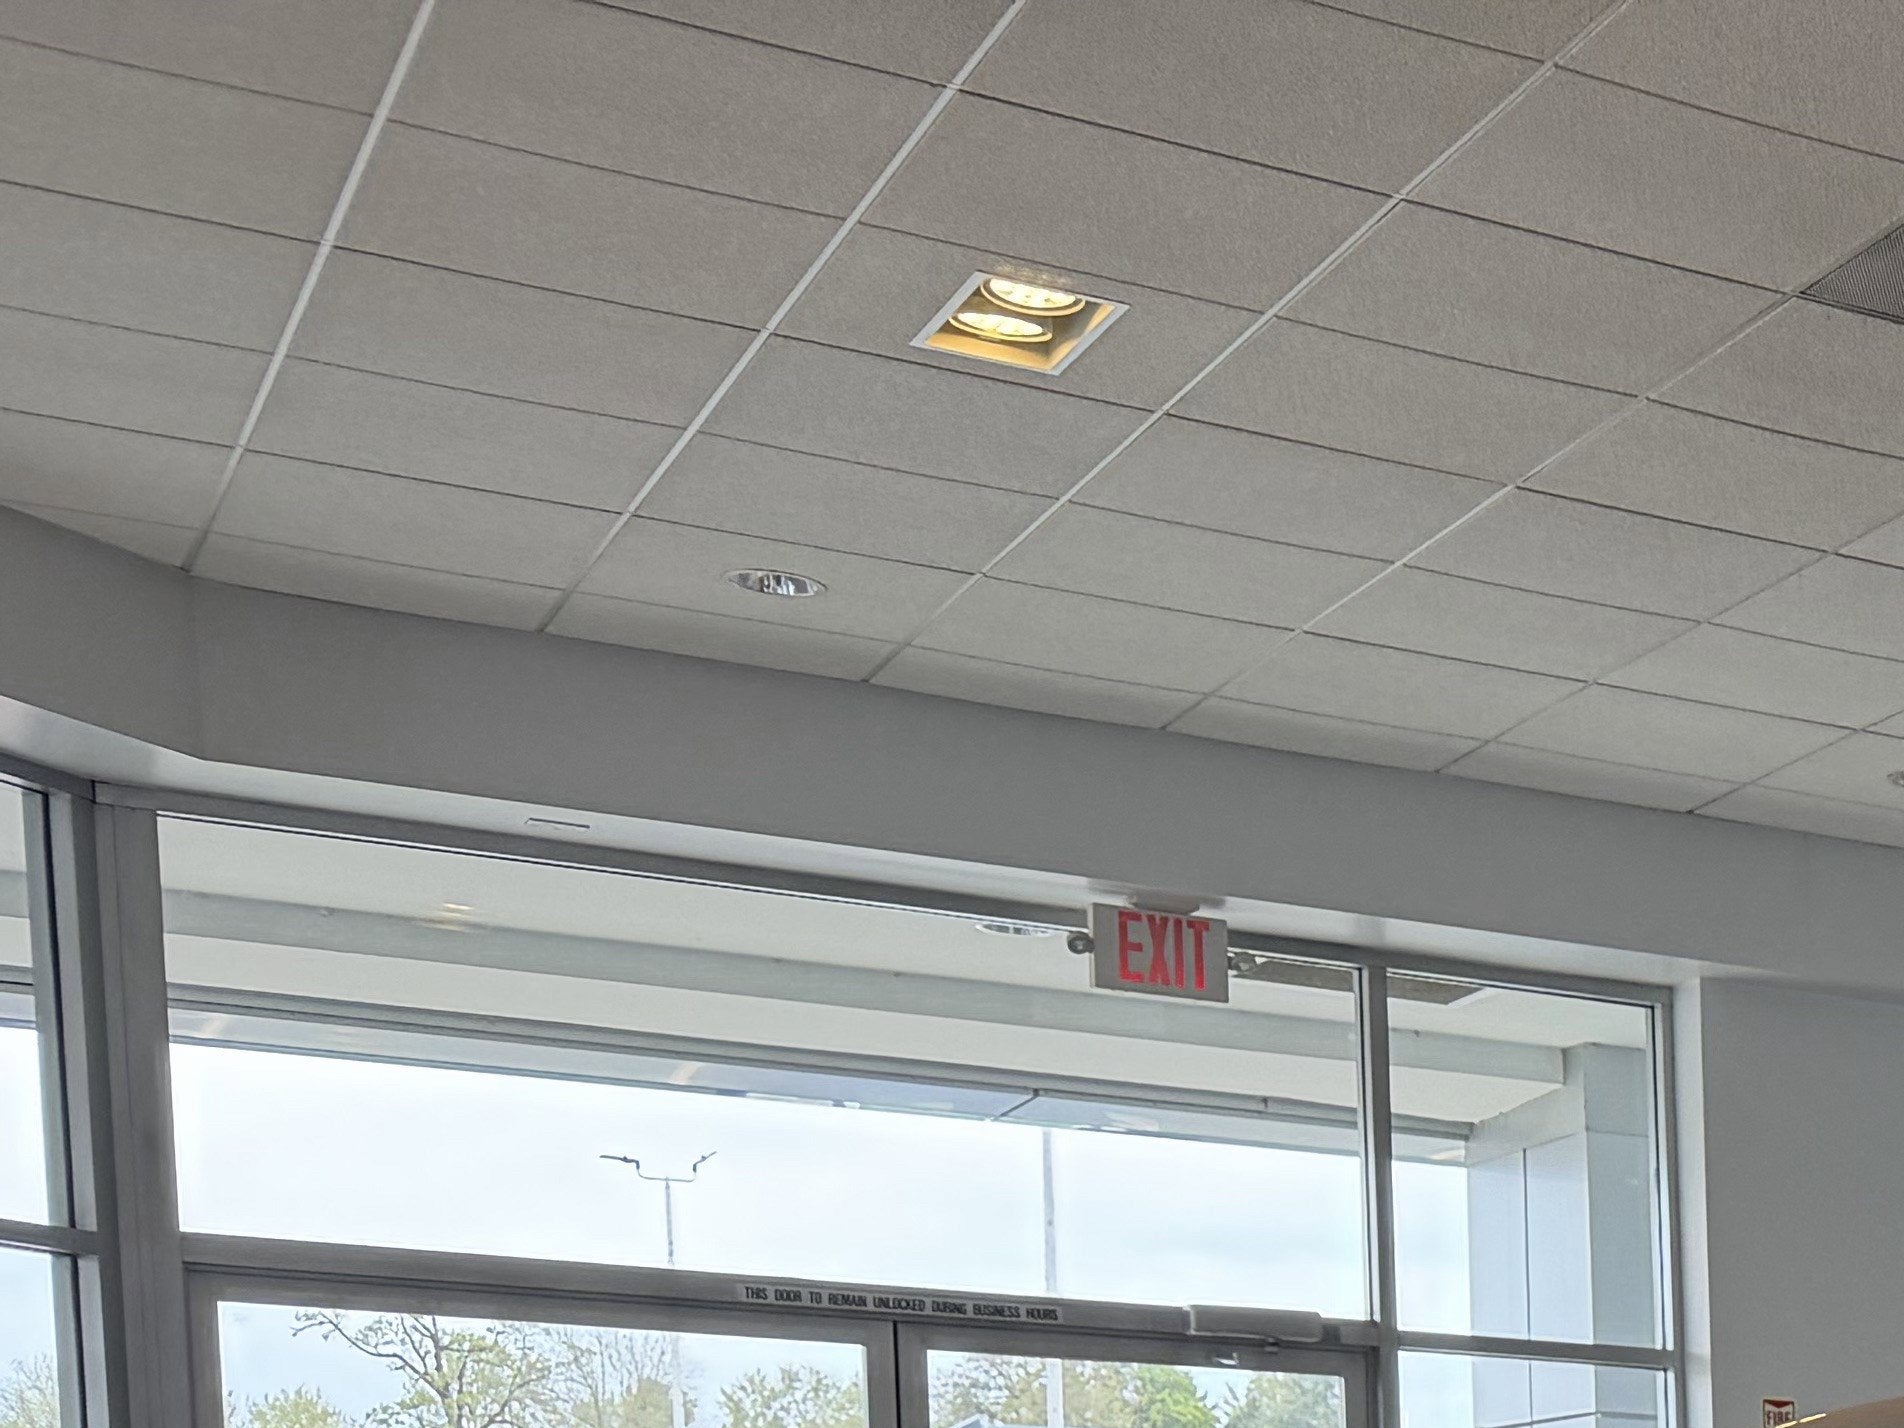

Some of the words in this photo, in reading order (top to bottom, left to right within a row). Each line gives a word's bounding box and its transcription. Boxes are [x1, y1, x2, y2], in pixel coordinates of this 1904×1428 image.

[1118, 909, 1212, 992] EXIT
[745, 1286, 768, 1300] THIS
[774, 1288, 802, 1303] DOOR
[809, 1291, 823, 1305] TO
[828, 1293, 867, 1308] REMAIN
[873, 1295, 926, 1312] UNLOCKED
[931, 1300, 967, 1315] DURING
[972, 1303, 1021, 1318] BUSINESS
[1026, 1307, 1059, 1321] HOURS
